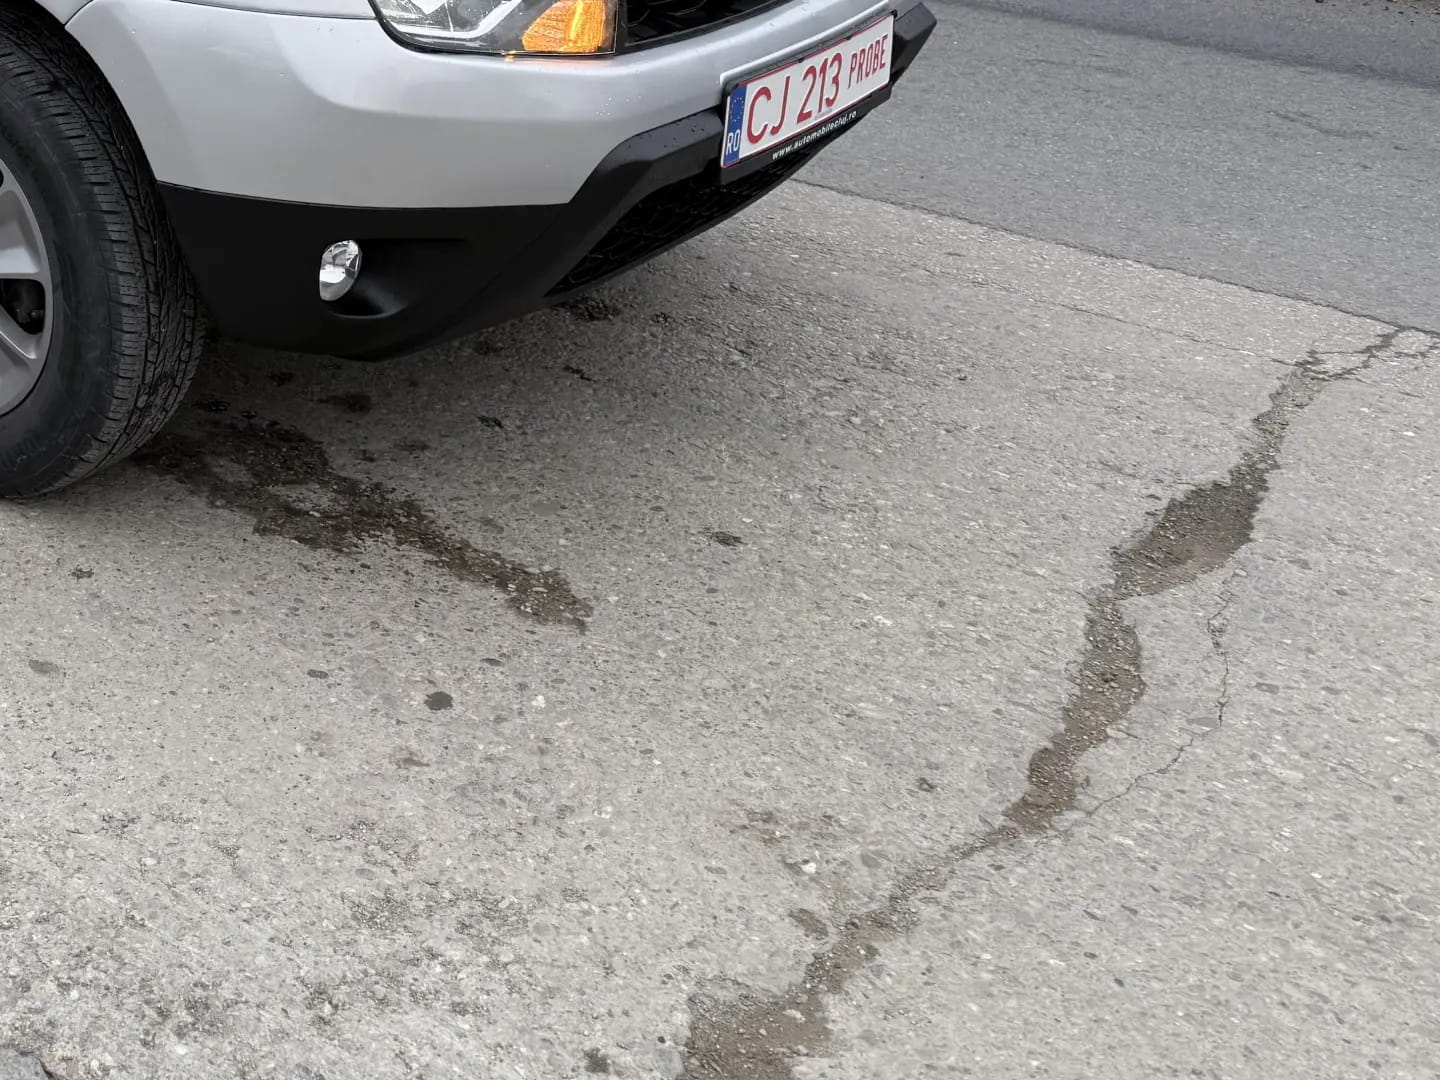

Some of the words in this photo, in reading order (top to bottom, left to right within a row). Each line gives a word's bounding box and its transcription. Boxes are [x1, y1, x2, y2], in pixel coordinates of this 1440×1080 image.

[746, 76, 791, 144] CJ
[796, 52, 843, 125] 213
[847, 33, 889, 89] PROBE
[725, 128, 741, 155] RO
